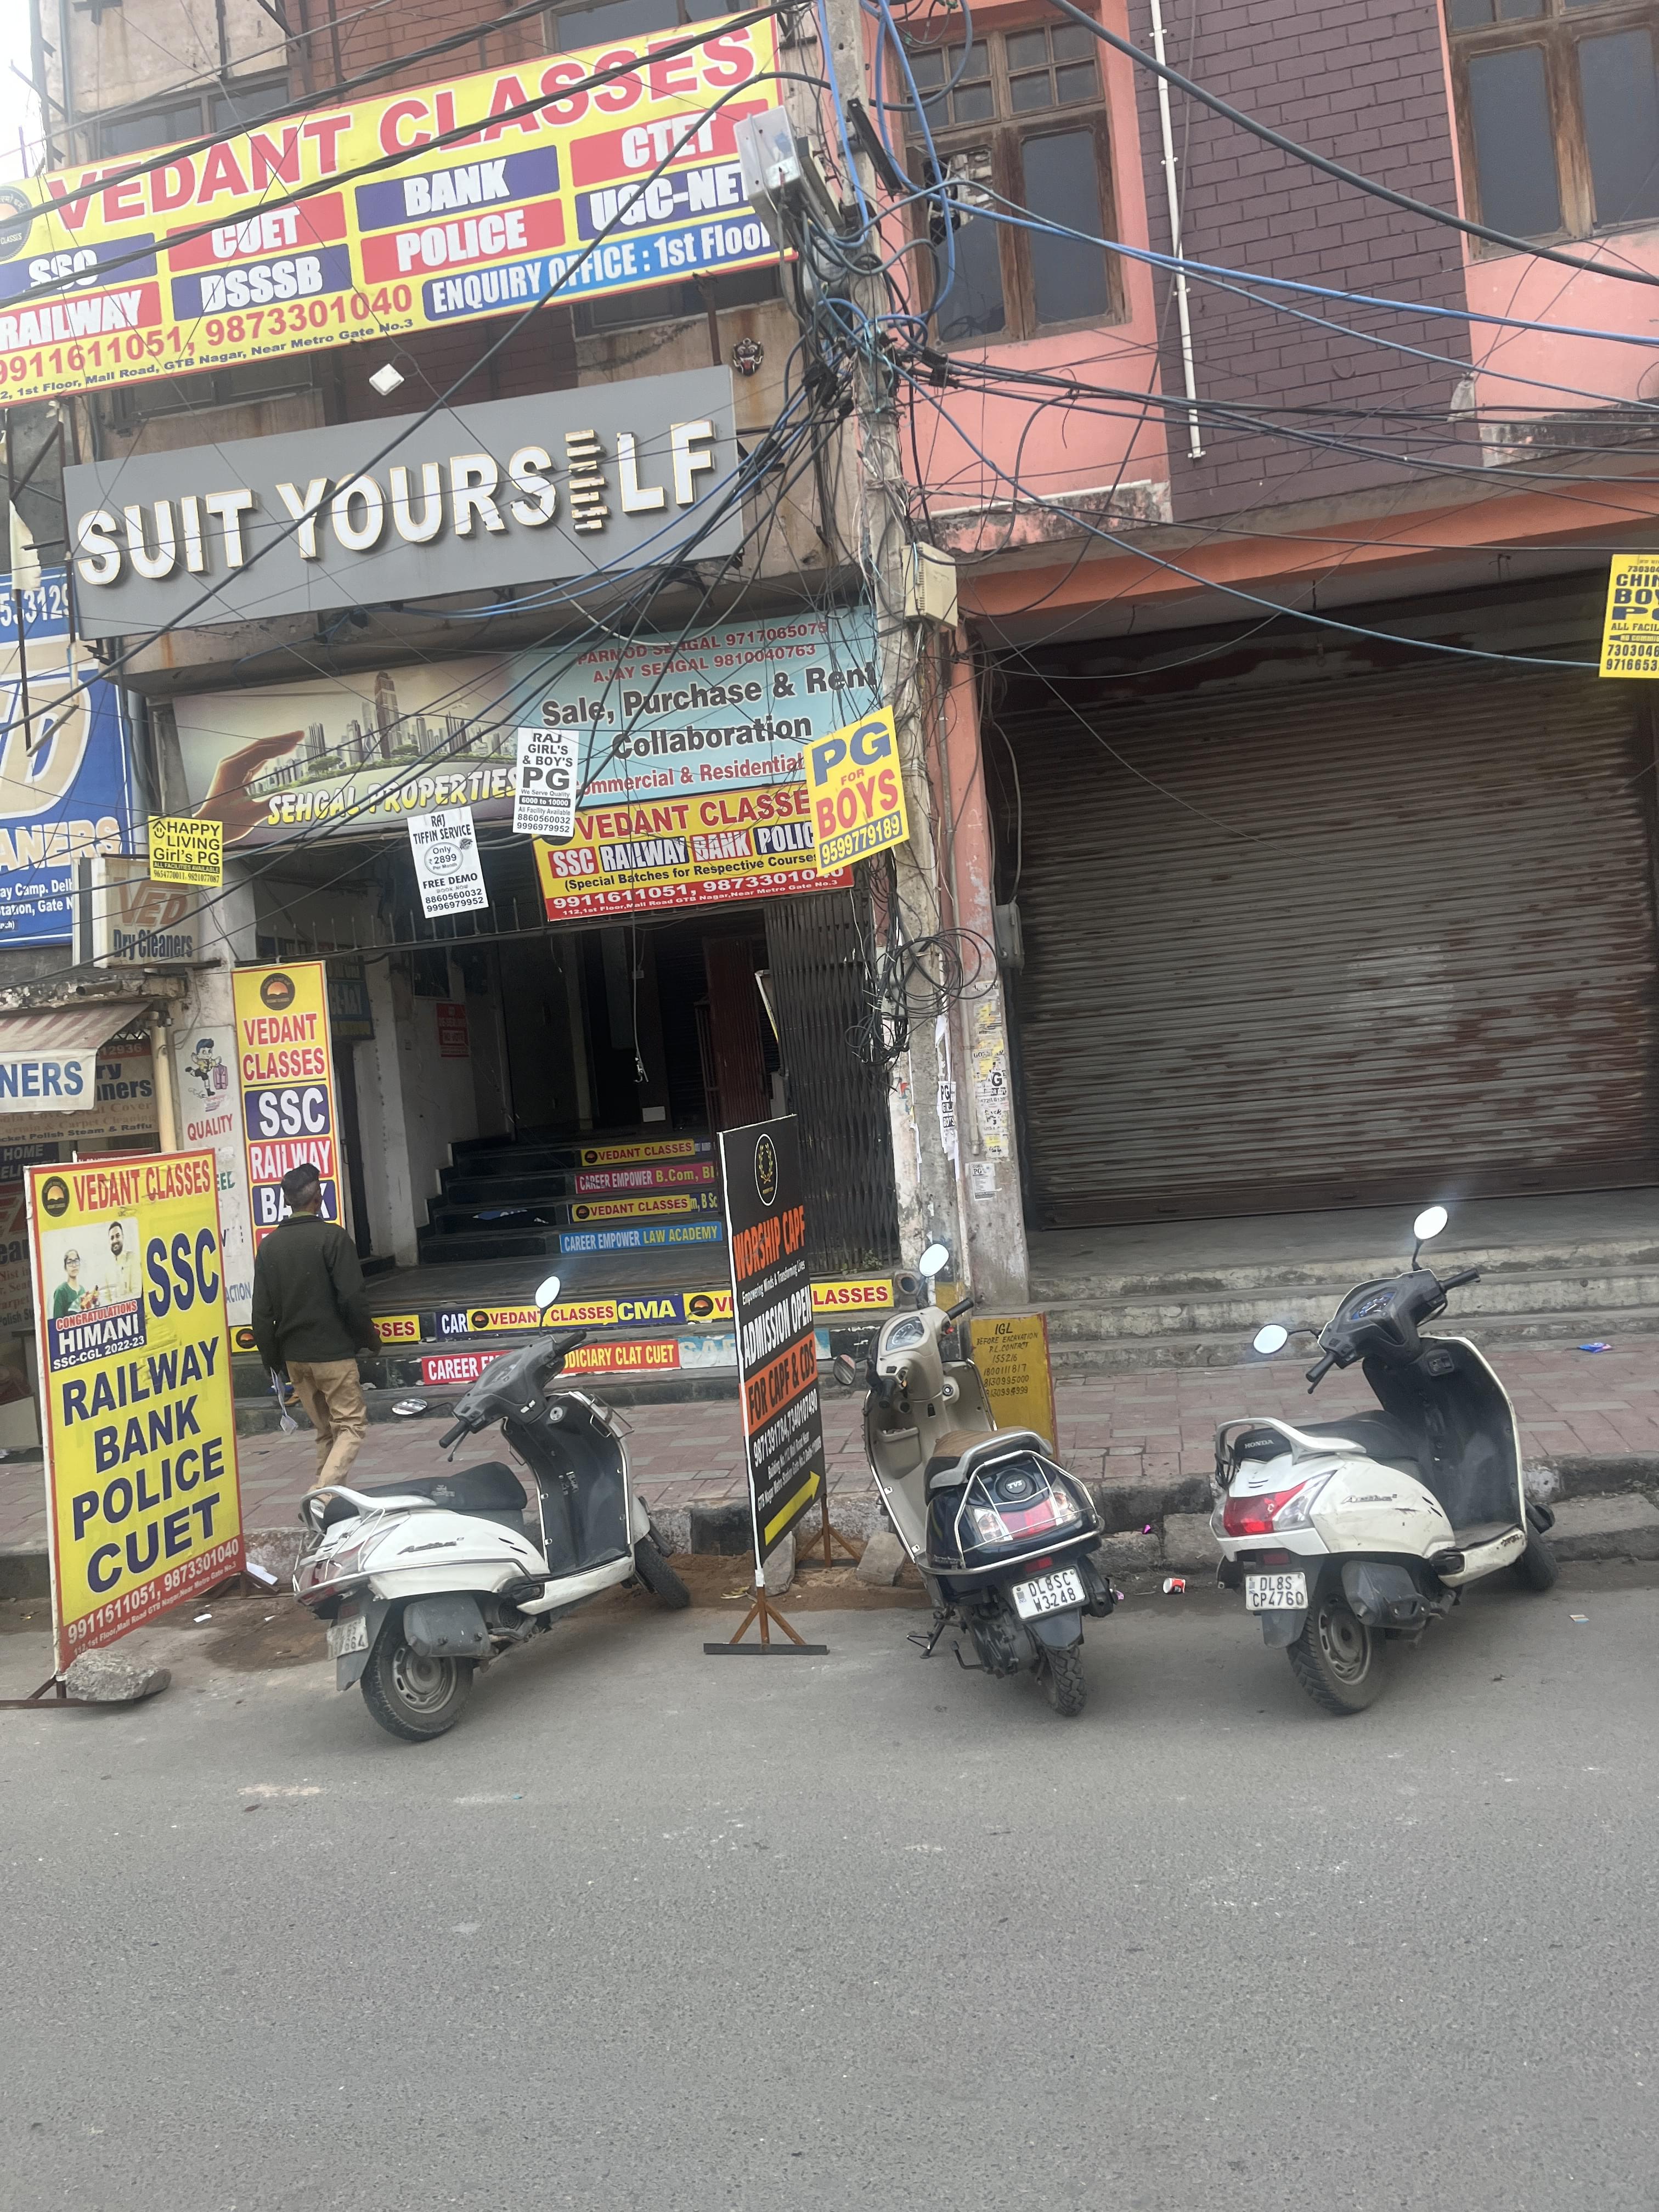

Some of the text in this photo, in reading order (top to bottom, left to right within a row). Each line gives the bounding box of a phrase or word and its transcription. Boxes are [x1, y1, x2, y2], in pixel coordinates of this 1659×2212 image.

[49, 27, 755, 230] VEDANT CLASSES
[622, 114, 717, 168] CTET
[403, 159, 510, 217] BANK
[211, 207, 301, 258] CUET
[396, 210, 527, 272] POLICE
[200, 256, 323, 313] DSSSB
[433, 236, 696, 314] ENQUIRY OFFICE 1st
[0, 290, 142, 352] RAILWAY
[206, 284, 412, 345] 9873301040
[17, 319, 414, 396] 1st Floor, Mall Road, GTB Nagar, Near Metro Gate No.3
[77, 488, 256, 586] SUIT
[577, 636, 720, 666] PARMOD SEHGAL
[593, 644, 816, 683] AJAY SEHGAL 9810040763
[541, 663, 876, 726] Sale, Purchase & Rent
[528, 744, 568, 755] GIRL'S
[533, 733, 562, 743] RAJ
[612, 714, 813, 760] Collaboration
[536, 756, 573, 767] BOY'S
[680, 754, 804, 784] & Residential
[812, 722, 891, 787] PG
[523, 766, 570, 791] PG
[840, 768, 865, 786] FOR
[267, 783, 360, 825] SEHGAL
[517, 814, 571, 824] 8860560032
[575, 789, 810, 842] VEDANT CLASSE
[816, 769, 898, 839] BOYS
[167, 821, 220, 837] HAPPY
[413, 824, 472, 845] TIFFIN SERVICE
[431, 814, 446, 827] RAJ
[517, 822, 569, 833] 9996979952
[167, 835, 219, 850] LIVING
[433, 846, 451, 854] Only
[695, 832, 751, 861] BANK
[757, 822, 815, 853] POLIC
[822, 815, 900, 865] 9599779189
[154, 848, 219, 865] Girl's PG
[552, 849, 595, 876] SSC
[601, 838, 687, 871] RAILWAY
[423, 873, 478, 889] FREE DEMO
[565, 859, 764, 893] (Special Batches for Respective
[38, 899, 63, 912] Gate
[425, 888, 483, 904] 8860560032
[427, 897, 484, 912] 9996979952
[553, 883, 696, 910] 9911611051,
[650, 898, 674, 906] Road
[675, 895, 696, 904] GTB
[757, 885, 786, 894] Metro
[788, 883, 812, 891] Gate
[114, 929, 193, 961] Dry Cleaners
[243, 1013, 317, 1046] VEDANT
[242, 1047, 325, 1081] CLASSES
[259, 1087, 325, 1137] SSC
[188, 1114, 233, 1141] QUALITY
[599, 1148, 641, 1161] VEDANT
[644, 1142, 692, 1156] CLASSES
[73, 1169, 140, 1211] VEDANT
[145, 1160, 211, 1201] CLASSES
[579, 1170, 653, 1190] CAREER EMPOWER
[590, 1198, 687, 1217] VEDANT CLASSES
[564, 1226, 718, 1251] CAREER EMPOWER LAW ACADEMY
[733, 1205, 805, 1282] WORSHIP CAPF
[146, 1228, 219, 1317] SSC
[617, 1299, 676, 1321] CMA
[813, 1286, 888, 1305] LASSES
[56, 1301, 137, 1331] CONGRATULATIONS
[551, 1305, 614, 1322] CLASSES
[743, 1298, 790, 1369] ADMISSION
[791, 1284, 812, 1332] OPEN
[995, 1322, 1013, 1335] IGL
[59, 1314, 139, 1355] HIMANI
[976, 1337, 1000, 1345] BEFORE
[53, 1335, 145, 1369] SSC-CGL 2022-23
[615, 1345, 642, 1365] CLAT
[645, 1344, 674, 1364] CUET
[992, 1353, 1018, 1363] 155216
[62, 1336, 219, 1426] RAILWAY
[428, 1357, 478, 1381] CAREER
[748, 1339, 815, 1425] FOR CAPF CDS
[94, 1394, 201, 1474] BANK
[73, 1436, 225, 1541] POLICE
[1007, 1480, 1023, 1489] TVS
[87, 1492, 221, 1594] CUET
[69, 1538, 239, 1644] 9911611051, 9873301040
